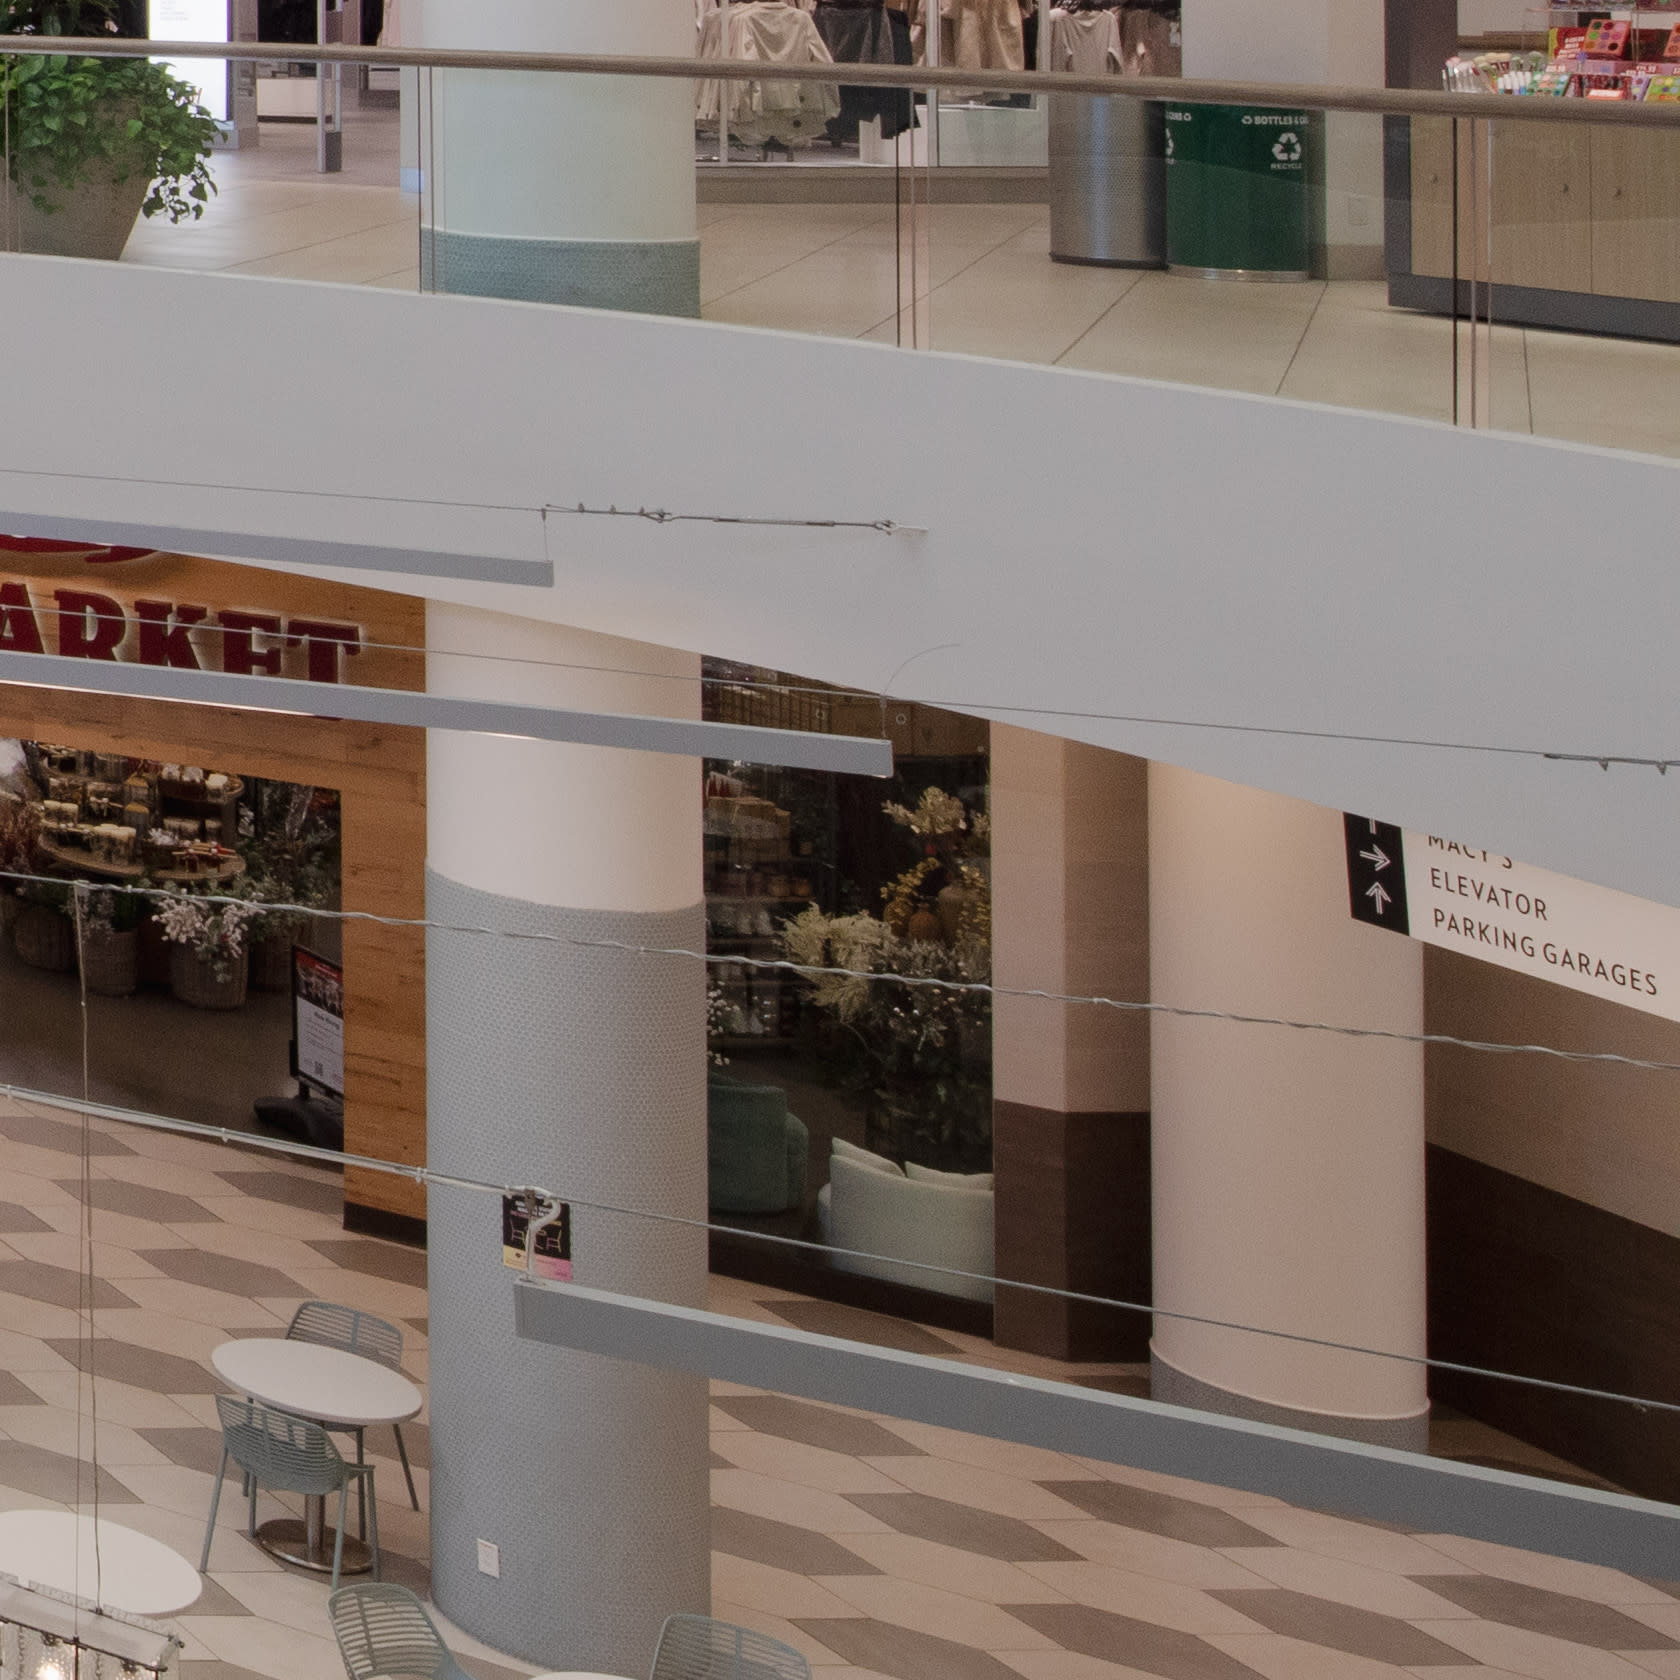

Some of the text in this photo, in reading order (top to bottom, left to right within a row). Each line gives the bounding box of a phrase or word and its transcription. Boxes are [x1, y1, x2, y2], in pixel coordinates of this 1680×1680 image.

[1254, 116, 1293, 125] BOTTLES
[1431, 867, 1549, 922] ELEVATOR
[1433, 907, 1659, 996] PARKING GARAGES
